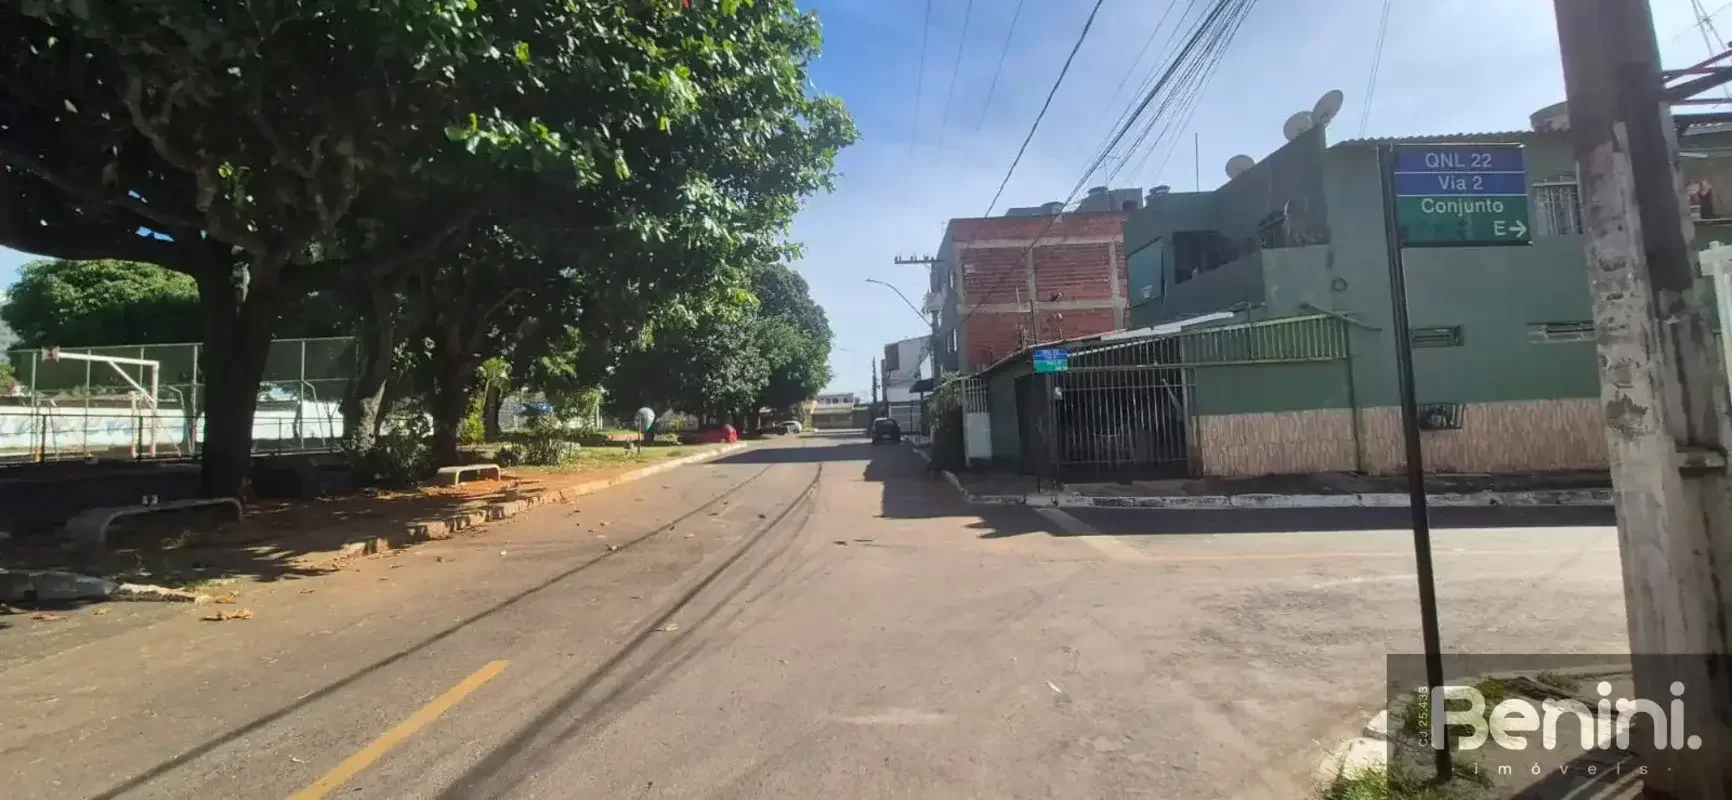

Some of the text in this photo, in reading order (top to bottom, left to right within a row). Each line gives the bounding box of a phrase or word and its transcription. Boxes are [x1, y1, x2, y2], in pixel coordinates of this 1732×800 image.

[1425, 152, 1492, 168] QNL 22
[1438, 175, 1484, 190] Via 2
[1421, 198, 1504, 217] Conjunto
[1494, 220, 1506, 236] E
